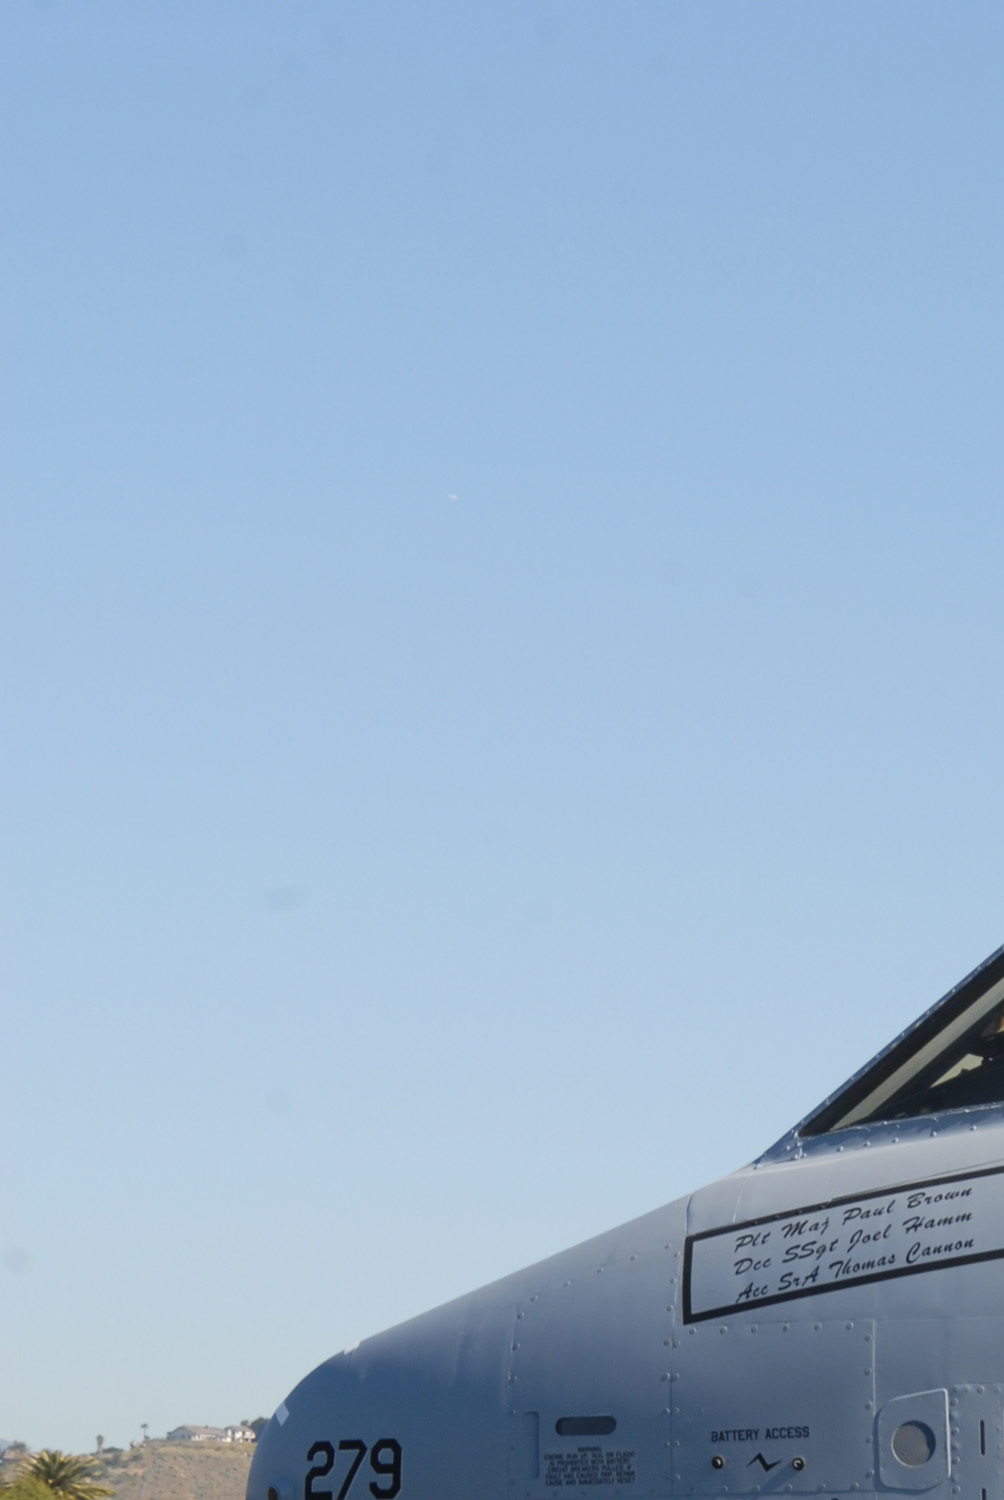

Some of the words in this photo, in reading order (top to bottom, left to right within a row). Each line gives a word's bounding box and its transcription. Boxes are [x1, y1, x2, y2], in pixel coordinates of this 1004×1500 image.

[733, 1256, 772, 1276] Dcc
[781, 1239, 839, 1264] SSgt
[847, 1223, 892, 1253] Joel
[902, 1210, 973, 1234] Hamm
[734, 1231, 771, 1253] Plt
[781, 1216, 830, 1240] Maj
[841, 1199, 897, 1227] Paul
[907, 1186, 973, 1209] Brown
[735, 1281, 769, 1304] Acc
[777, 1265, 819, 1292] SrA
[828, 1253, 897, 1279] Thomas
[905, 1238, 975, 1264] Cannon
[710, 1428, 760, 1442] BATTERY
[765, 1426, 810, 1440] ACCESS
